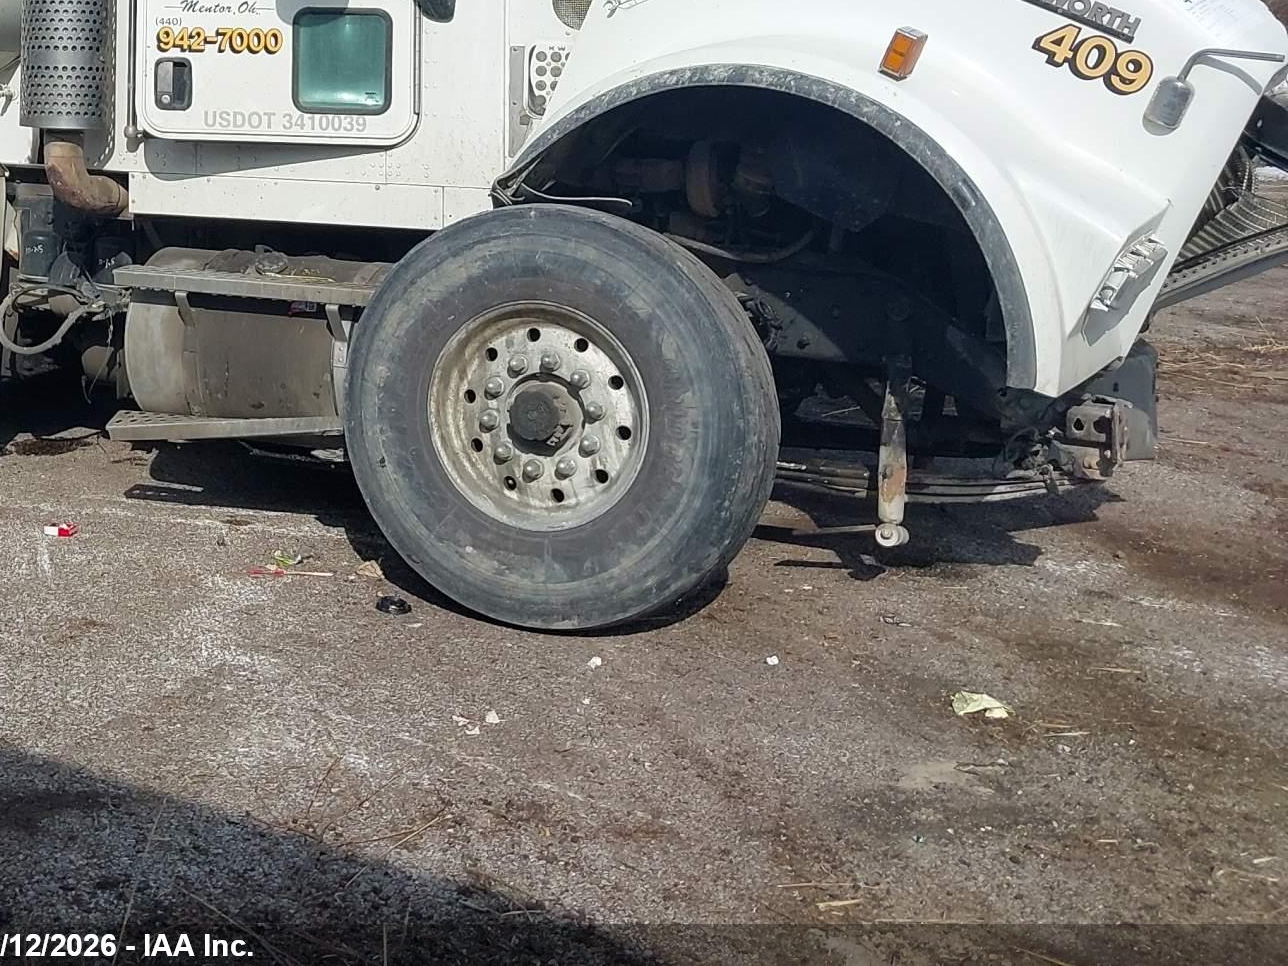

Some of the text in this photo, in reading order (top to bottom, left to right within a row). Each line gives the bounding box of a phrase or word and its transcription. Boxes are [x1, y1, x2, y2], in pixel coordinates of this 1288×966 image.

[155, 17, 182, 27] (440)
[157, 26, 283, 54] 942-7000
[1032, 23, 1154, 96] 409
[203, 111, 367, 133] USDOT 3410039
